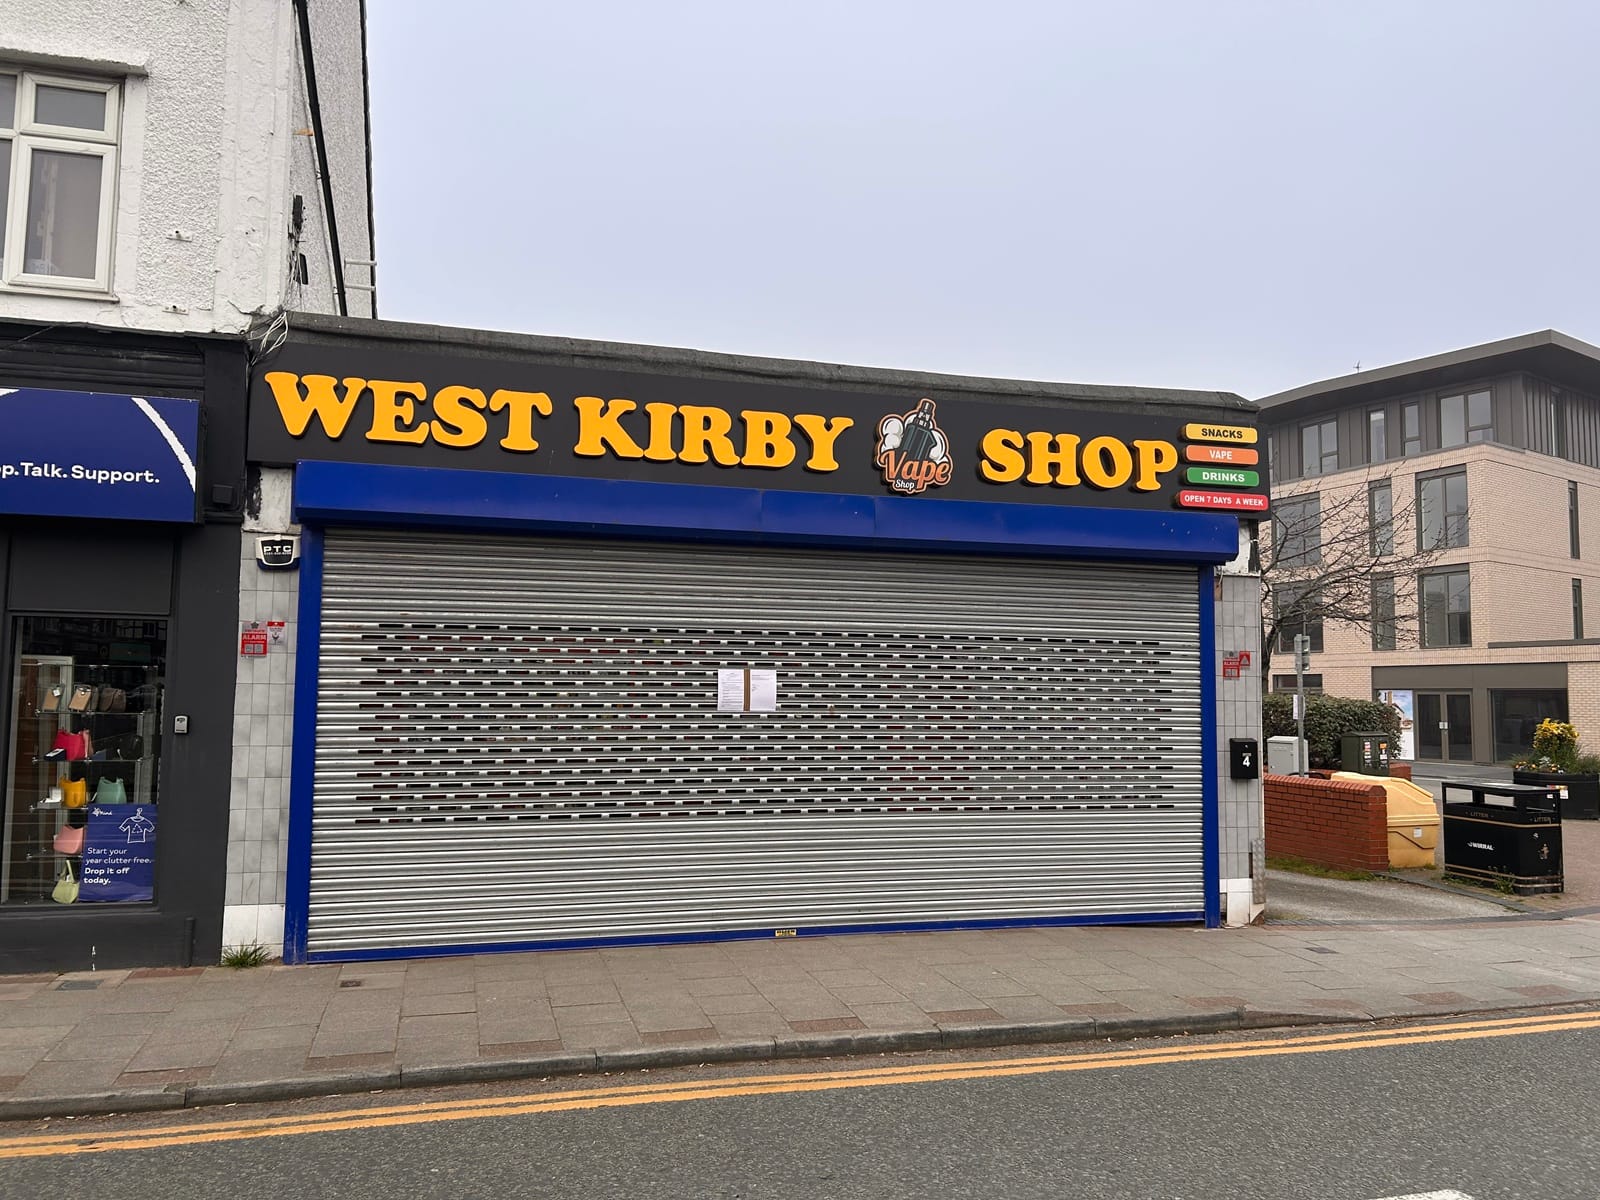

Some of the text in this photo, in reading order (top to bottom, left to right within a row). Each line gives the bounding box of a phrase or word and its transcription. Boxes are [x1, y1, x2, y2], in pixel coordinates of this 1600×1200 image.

[265, 371, 1178, 492] WEST KIRBY SHOP
[1201, 427, 1243, 439] SNACKS
[1209, 449, 1233, 460] VAPE
[20, 462, 67, 478] Talk.
[71, 465, 160, 484] Support.
[879, 450, 950, 489] Vape
[1202, 471, 1245, 483] DRINKS
[895, 479, 915, 490] Shop
[1184, 494, 1205, 504] OPEN
[1213, 496, 1232, 504] DAYS
[1235, 497, 1241, 505] A
[1242, 498, 1264, 506] WEEK
[263, 545, 292, 553] PTC
[1242, 756, 1251, 767] 4
[87, 847, 107, 855] Start
[85, 858, 102, 866] year
[133, 856, 152, 864] free.
[84, 867, 105, 876] Drop
[84, 877, 111, 885] today.
